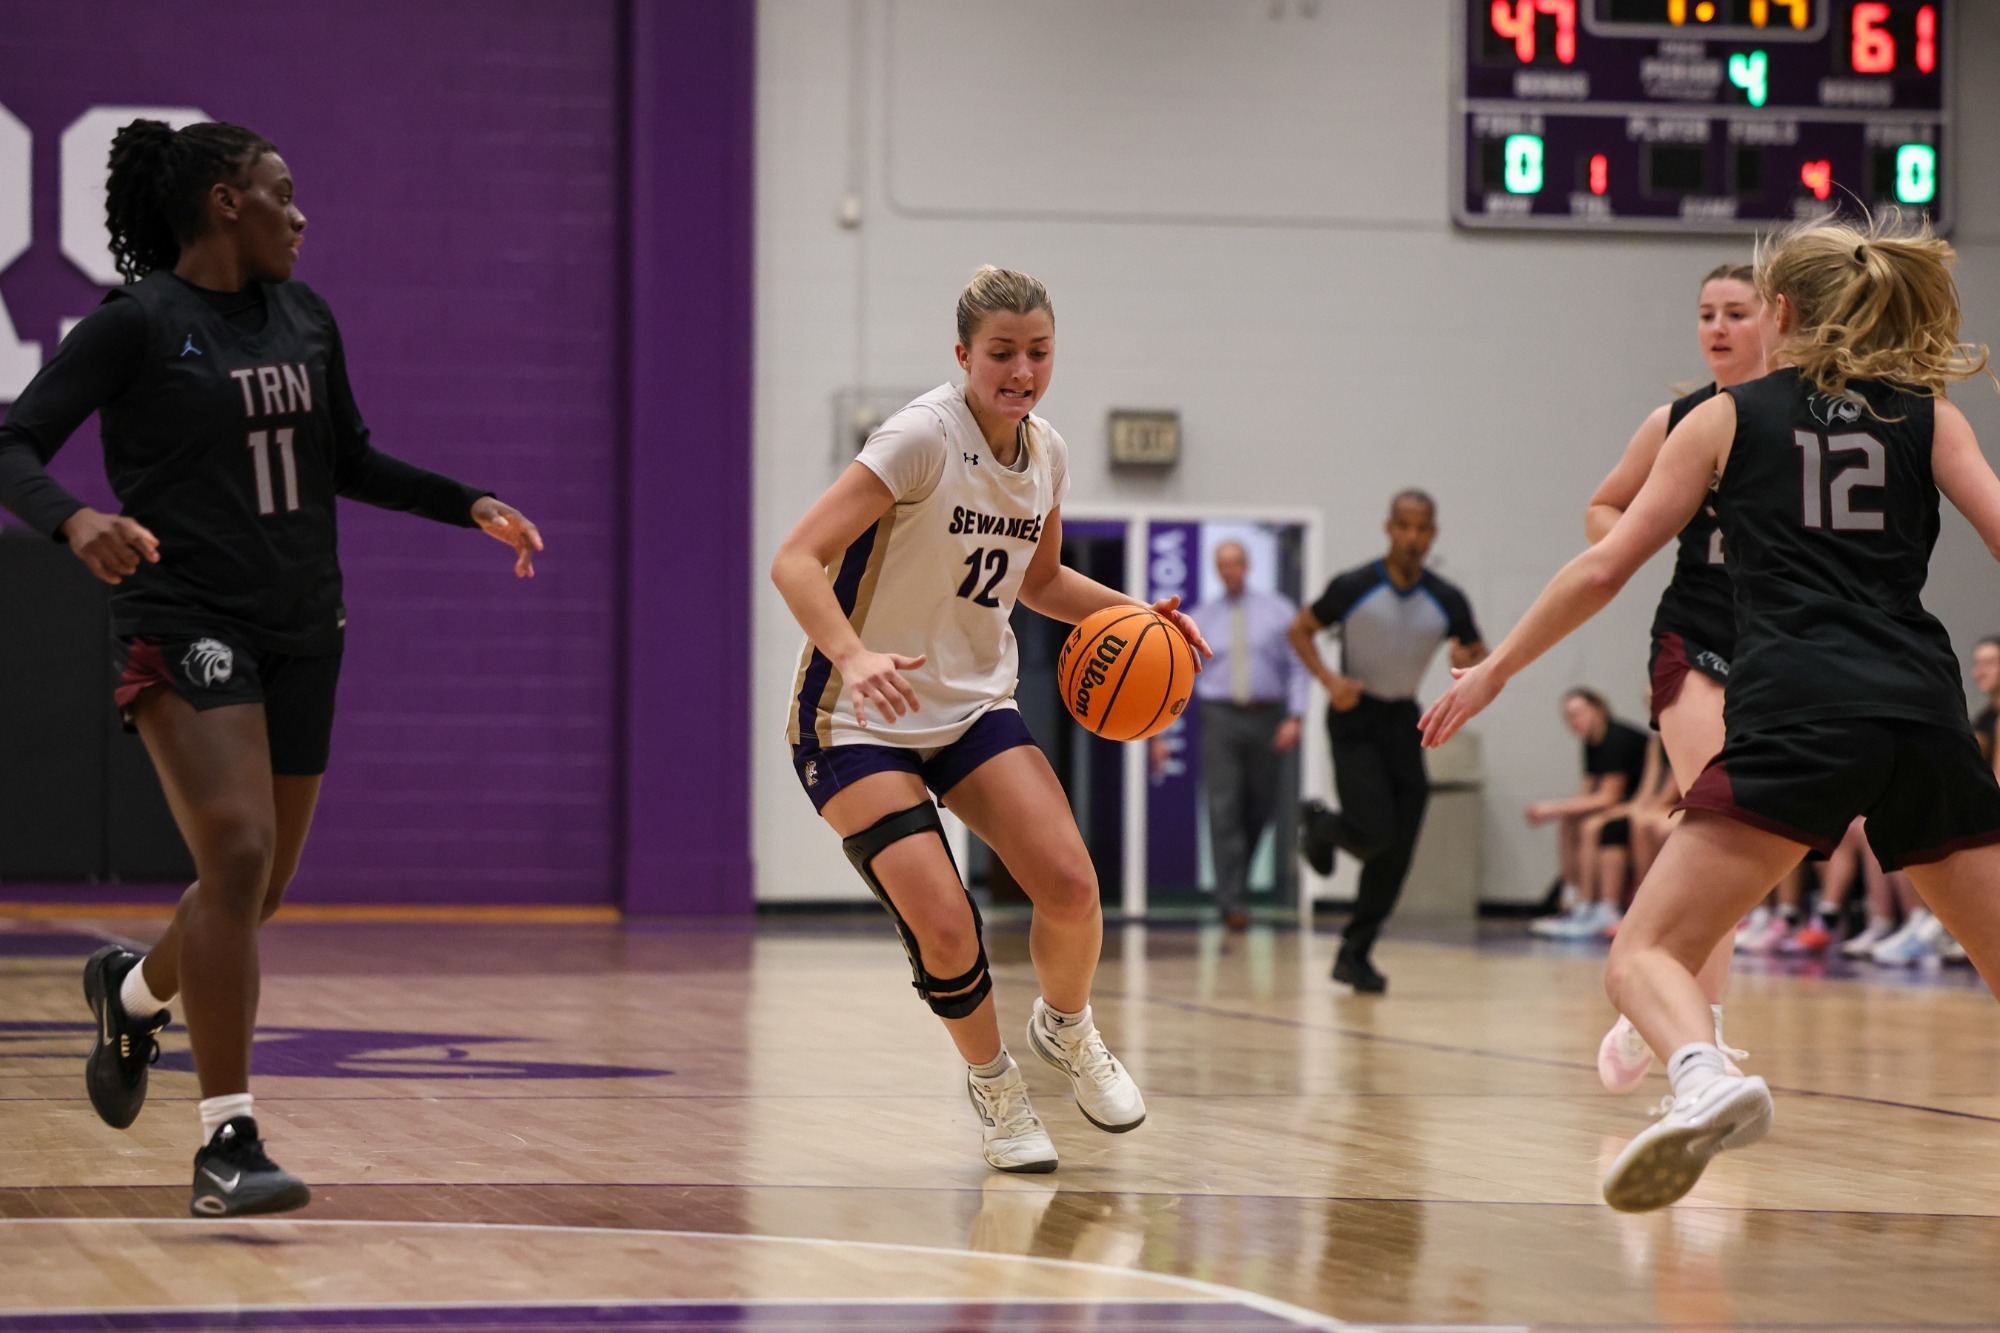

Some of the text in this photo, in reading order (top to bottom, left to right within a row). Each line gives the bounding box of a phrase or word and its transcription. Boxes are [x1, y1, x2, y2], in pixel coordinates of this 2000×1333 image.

[1852, 3, 1936, 73] 61
[1729, 50, 1767, 107] 4
[1505, 134, 1543, 194] 0
[1590, 154, 1607, 195] 1
[1801, 160, 1831, 200] 4
[1897, 144, 1935, 203] 0
[230, 362, 313, 418] TRN
[248, 427, 300, 516] 11
[1794, 429, 1886, 531] 12
[948, 505, 1041, 543] SEWANEE
[956, 547, 1009, 608] 12
[1076, 634, 1128, 718] Wilson
